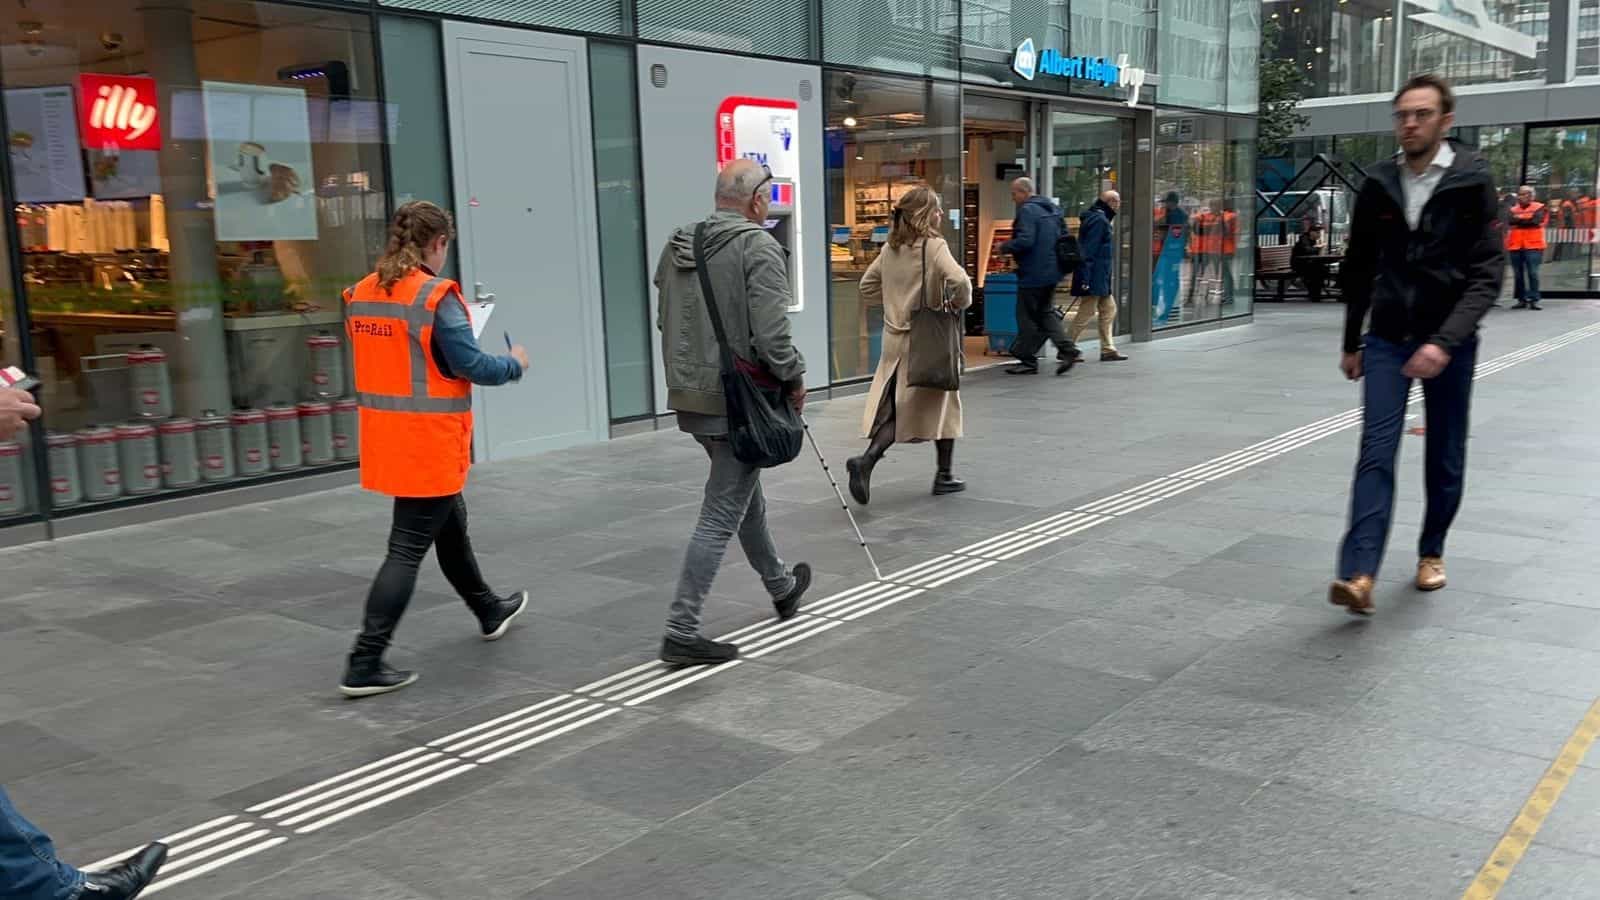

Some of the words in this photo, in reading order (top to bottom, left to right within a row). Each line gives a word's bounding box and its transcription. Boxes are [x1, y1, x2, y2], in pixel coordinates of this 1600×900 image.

[1039, 48, 1083, 79] Albert
[89, 84, 156, 141] illy
[354, 320, 393, 337] ProRail
